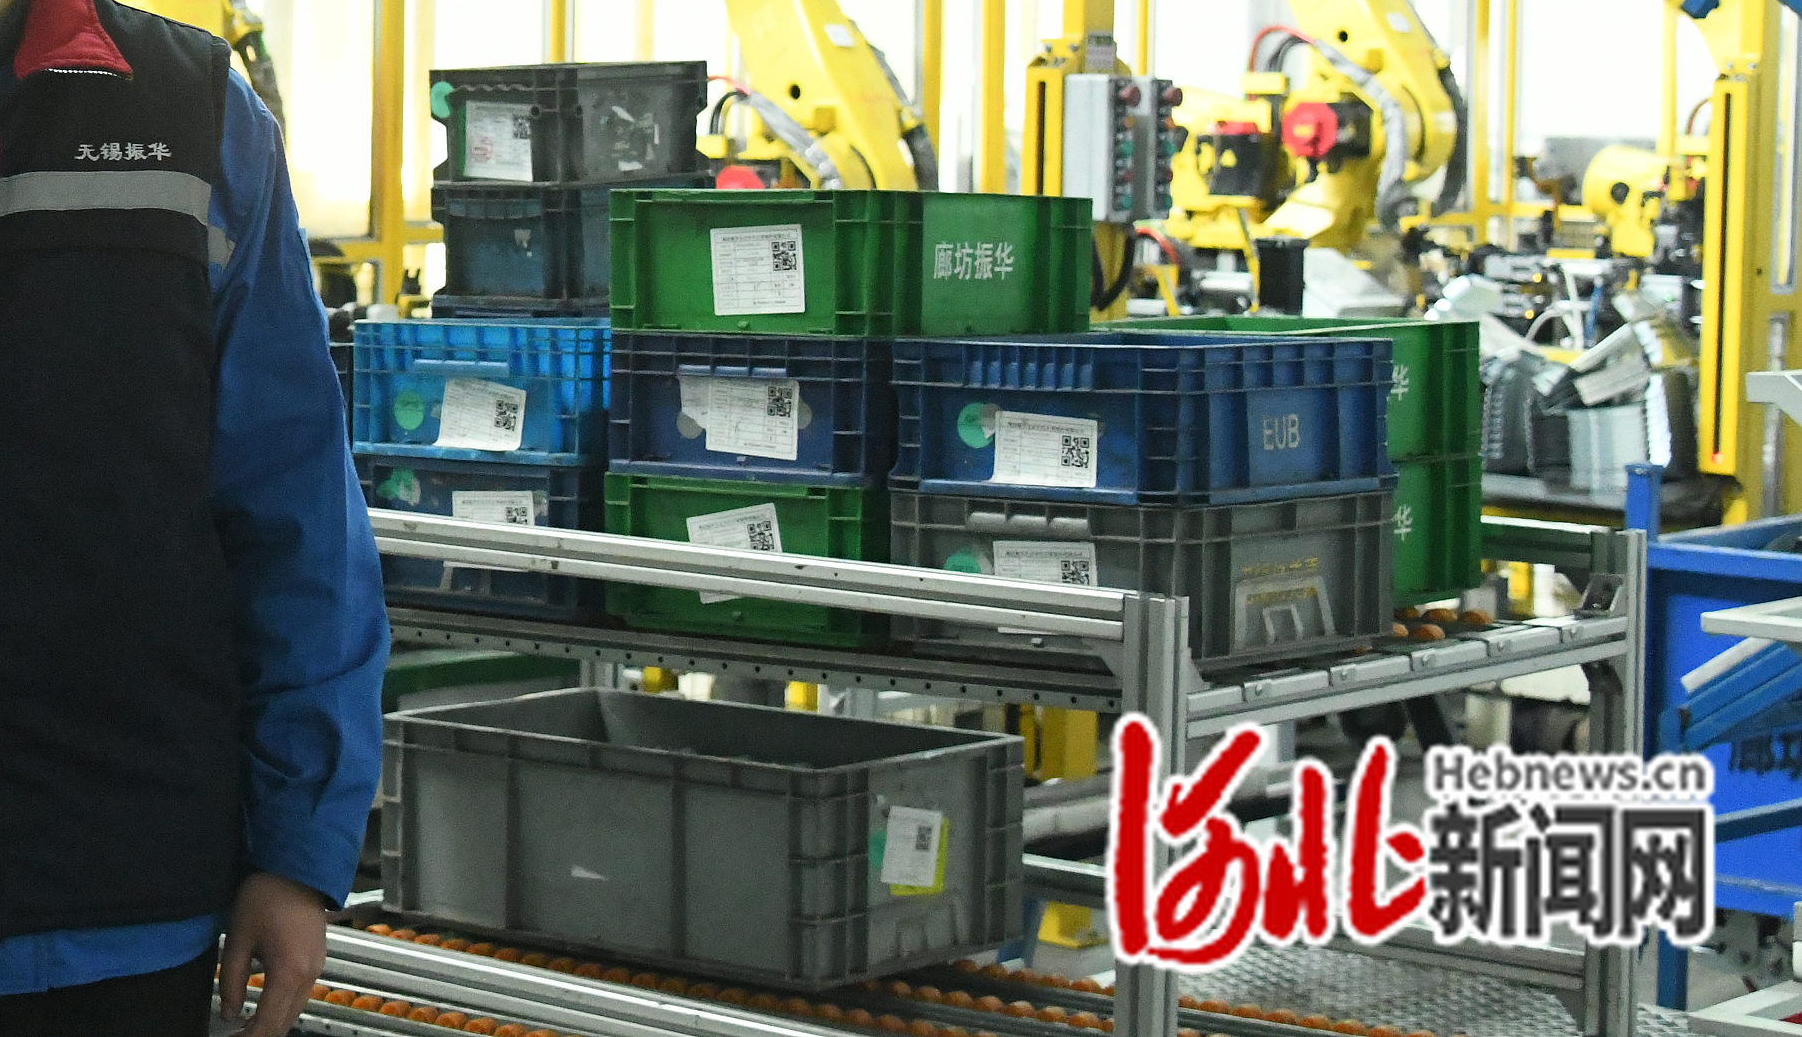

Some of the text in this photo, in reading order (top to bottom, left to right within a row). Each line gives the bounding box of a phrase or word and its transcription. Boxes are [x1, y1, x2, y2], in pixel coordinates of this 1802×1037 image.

[74, 142, 172, 162] 无锡振华
[933, 241, 1014, 280] 廊坊振华
[1263, 414, 1300, 451] EUB
